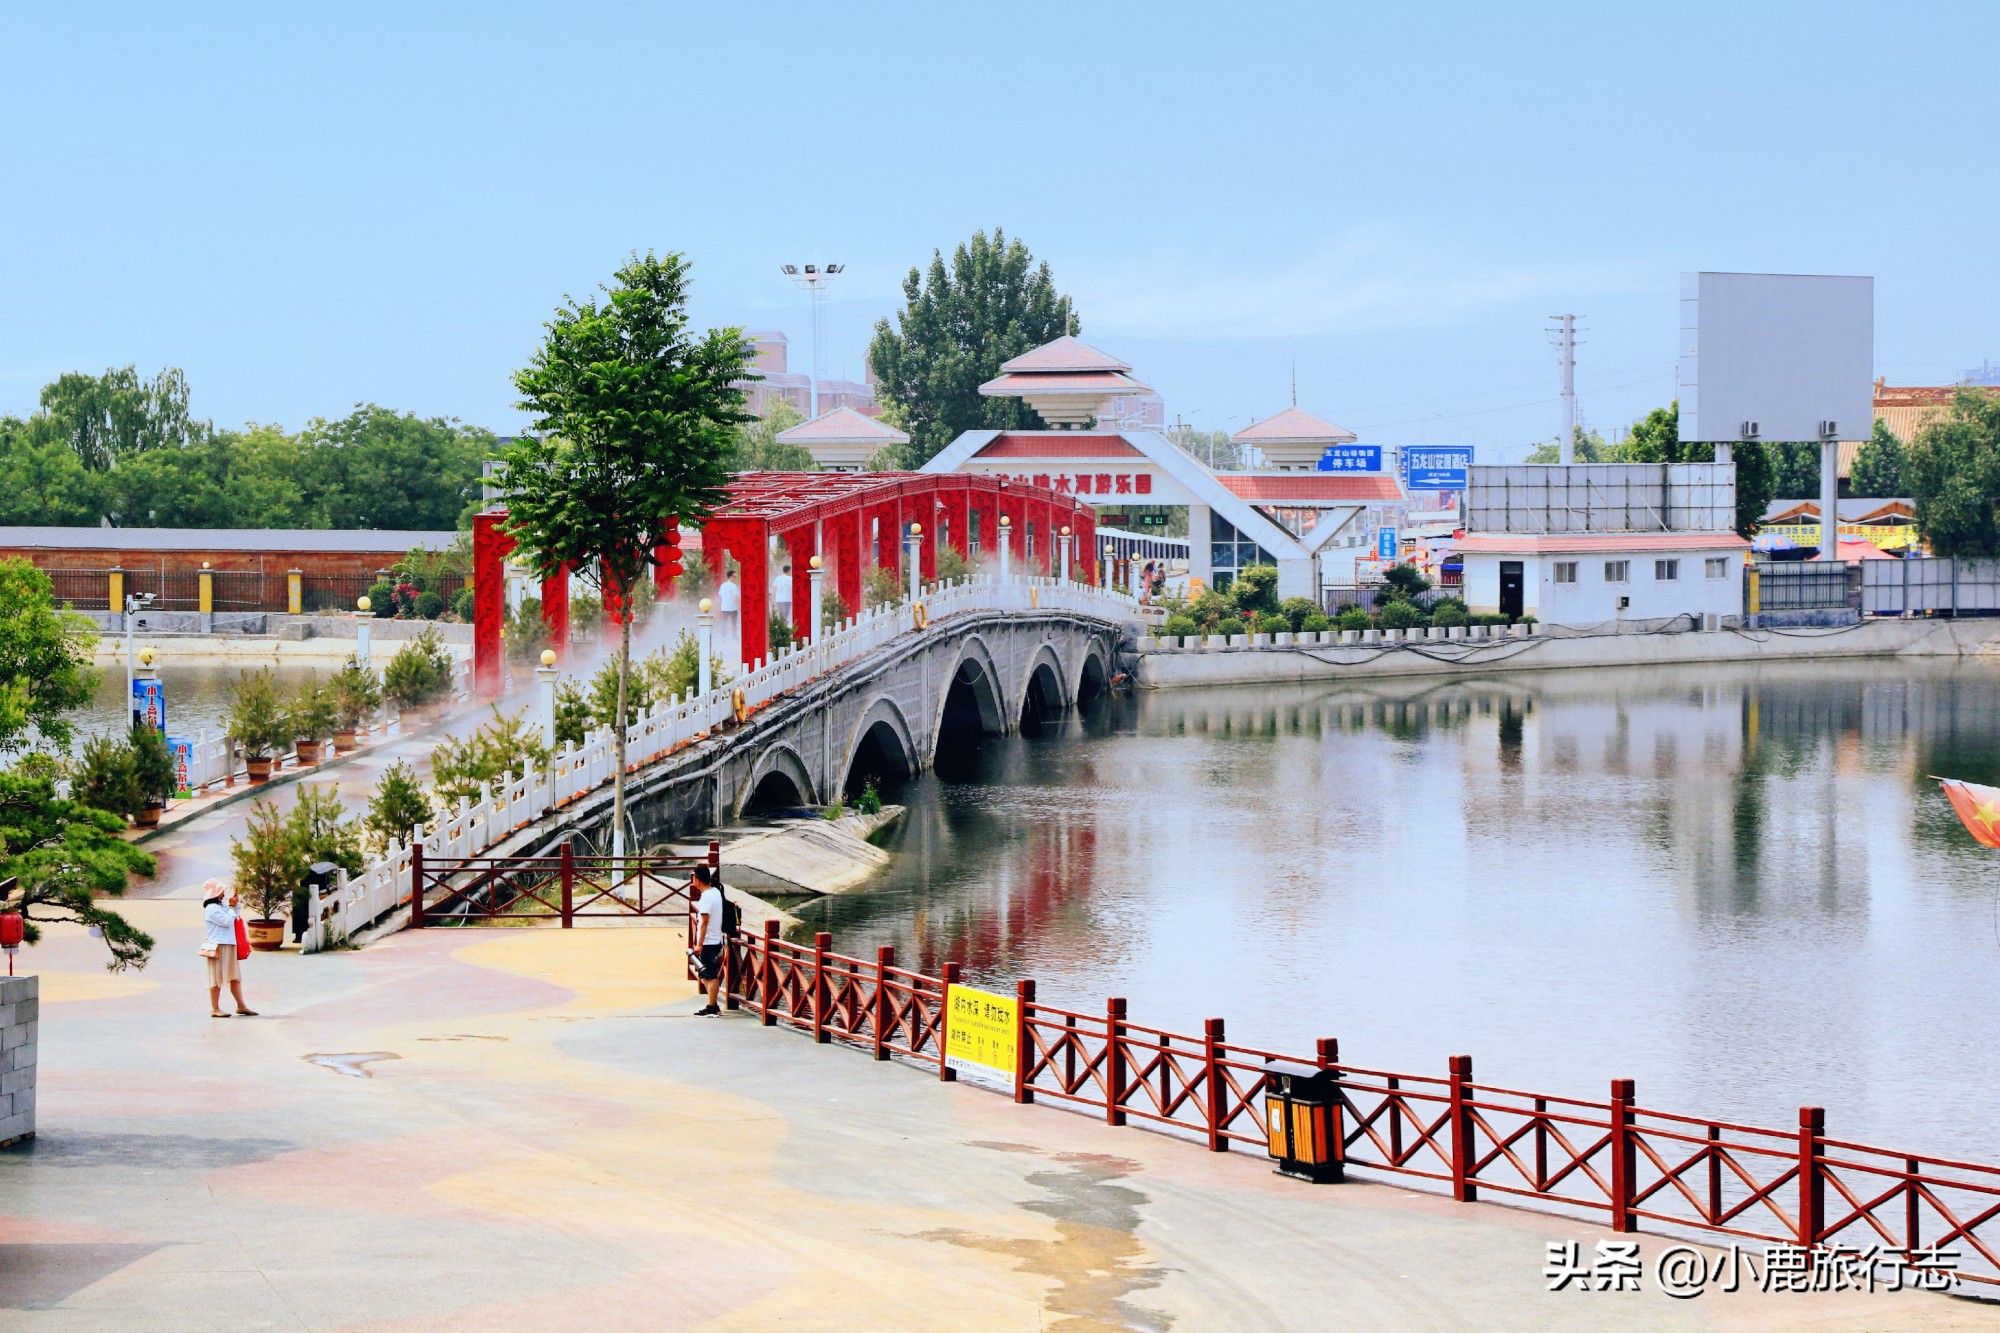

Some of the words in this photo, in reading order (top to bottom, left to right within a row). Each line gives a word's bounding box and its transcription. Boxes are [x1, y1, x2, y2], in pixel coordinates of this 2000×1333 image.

[1332, 458, 1368, 469] 停车场
[1411, 453, 1469, 470] 五龙山花园酒店
[981, 473, 1152, 495] 响水河游乐园
[1144, 516, 1163, 525] 出口
[178, 744, 188, 792] 水上高尔夫
